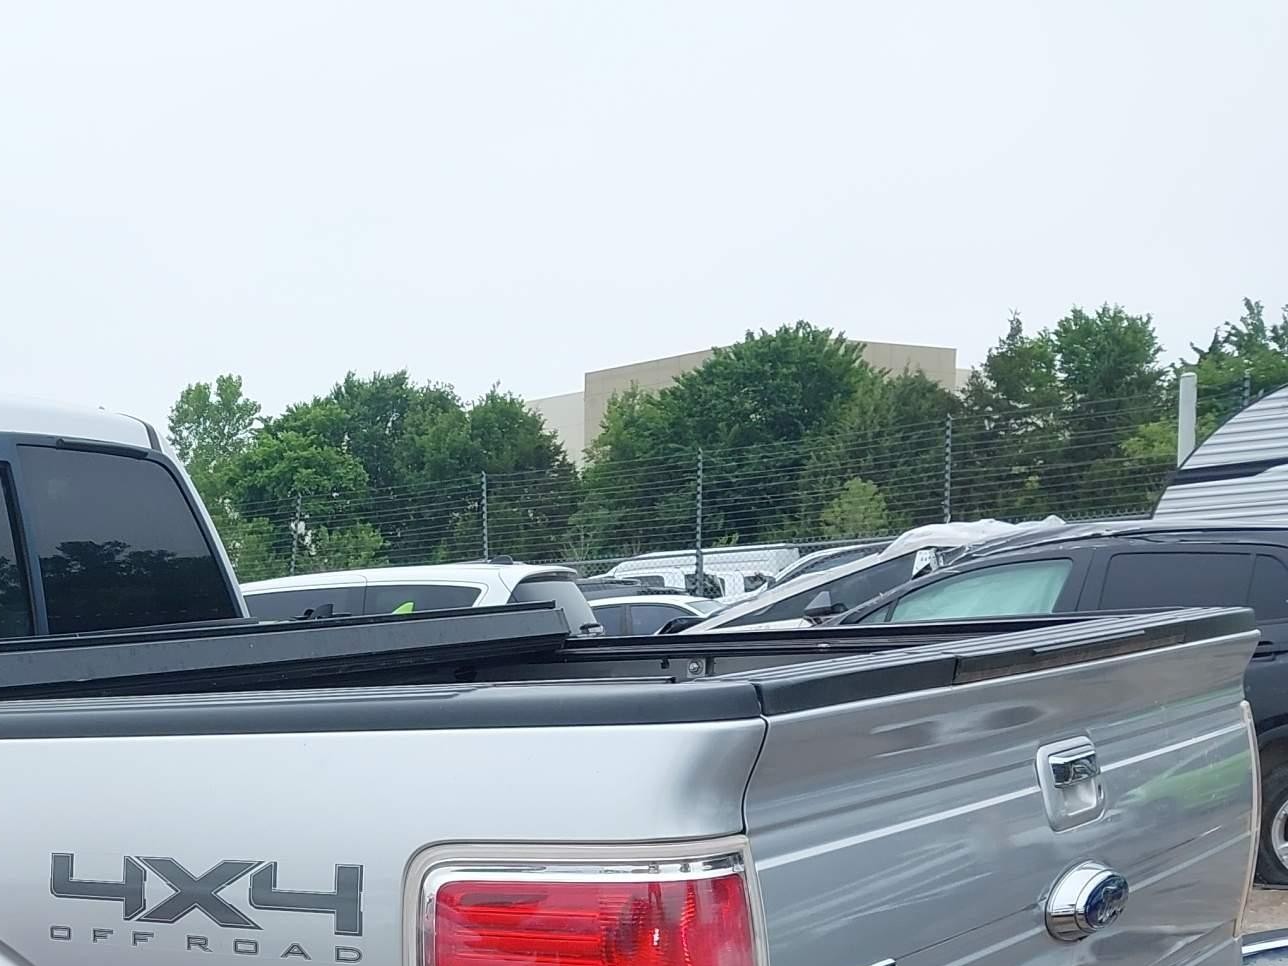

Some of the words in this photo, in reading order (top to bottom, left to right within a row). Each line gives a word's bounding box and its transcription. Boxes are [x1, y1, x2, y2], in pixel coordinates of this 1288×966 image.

[50, 852, 364, 936] 4X4
[49, 925, 155, 947] OFF
[186, 934, 363, 963] ROAD
